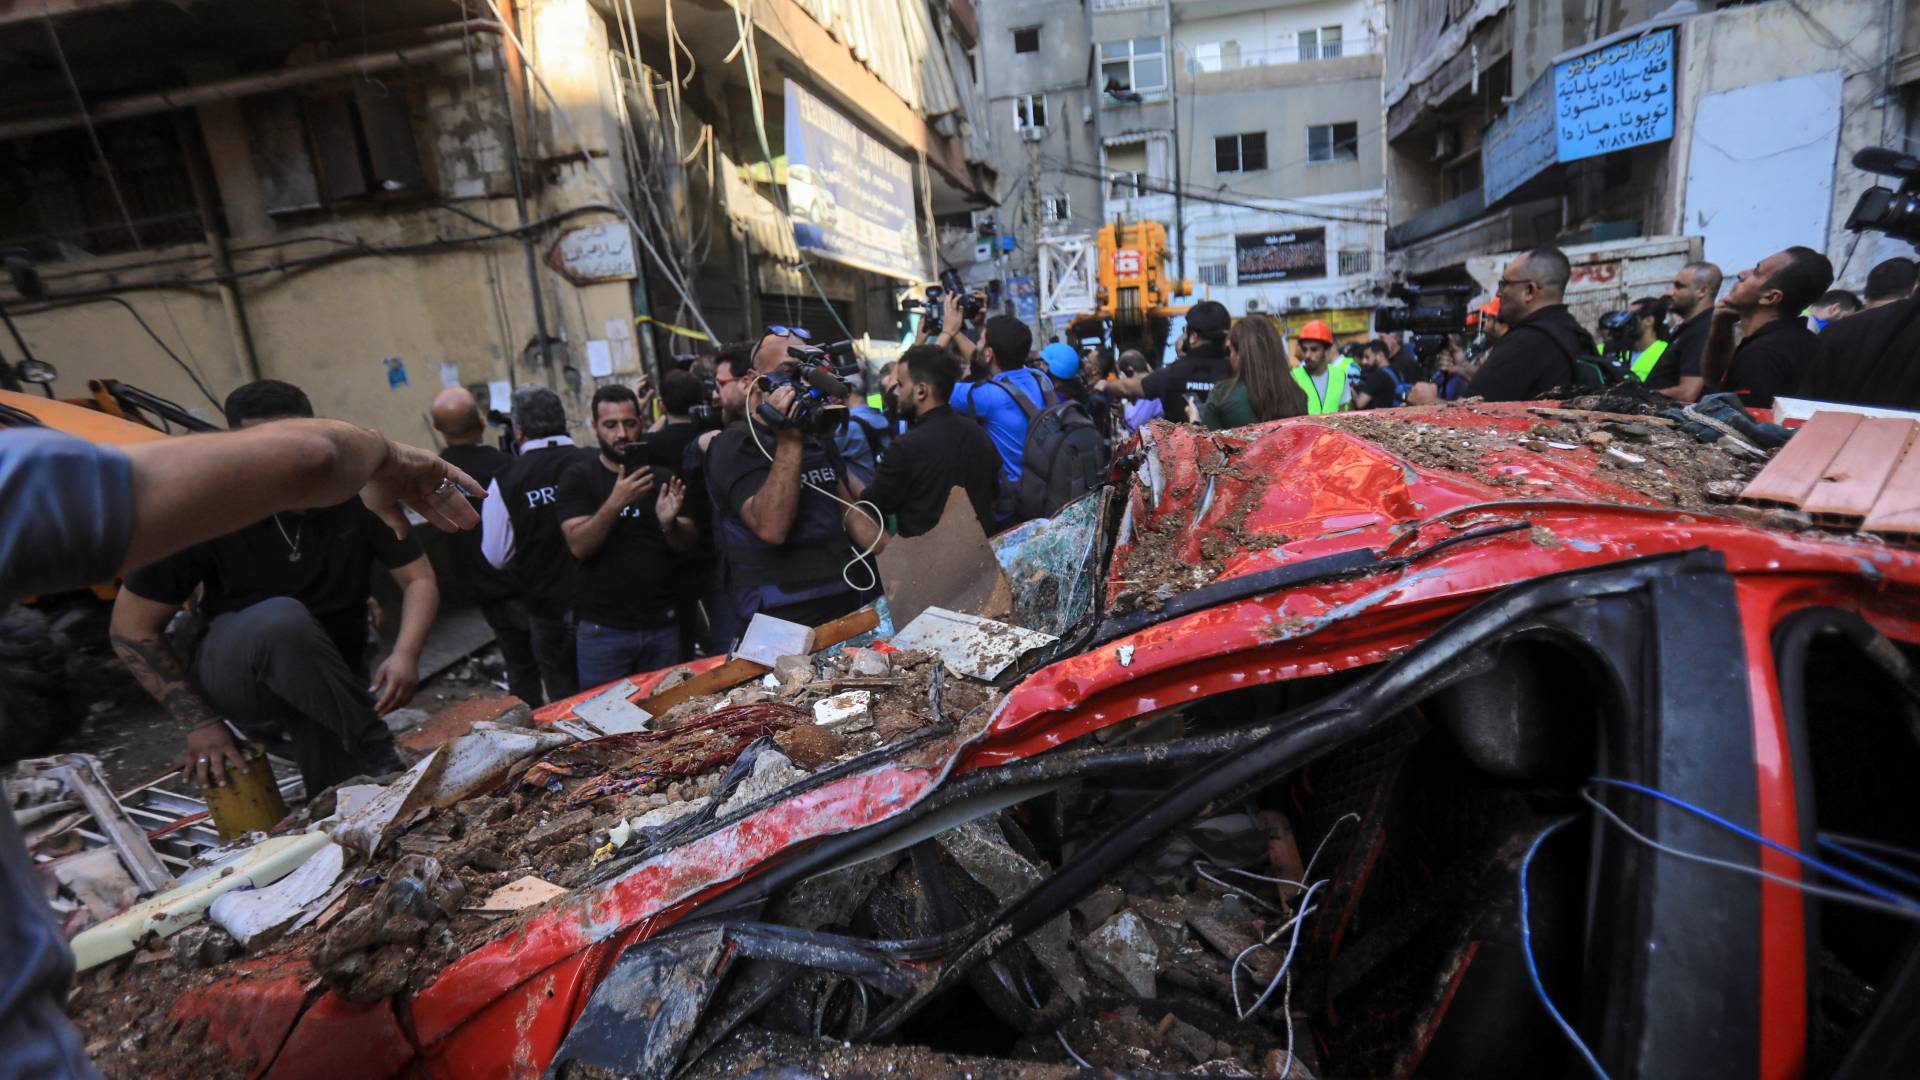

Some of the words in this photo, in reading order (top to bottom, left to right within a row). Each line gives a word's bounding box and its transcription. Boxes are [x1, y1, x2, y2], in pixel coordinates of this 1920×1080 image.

[1600, 68, 1642, 88] سيارات
[1642, 58, 1667, 81] قطع
[1561, 93, 1613, 119] داتسون
